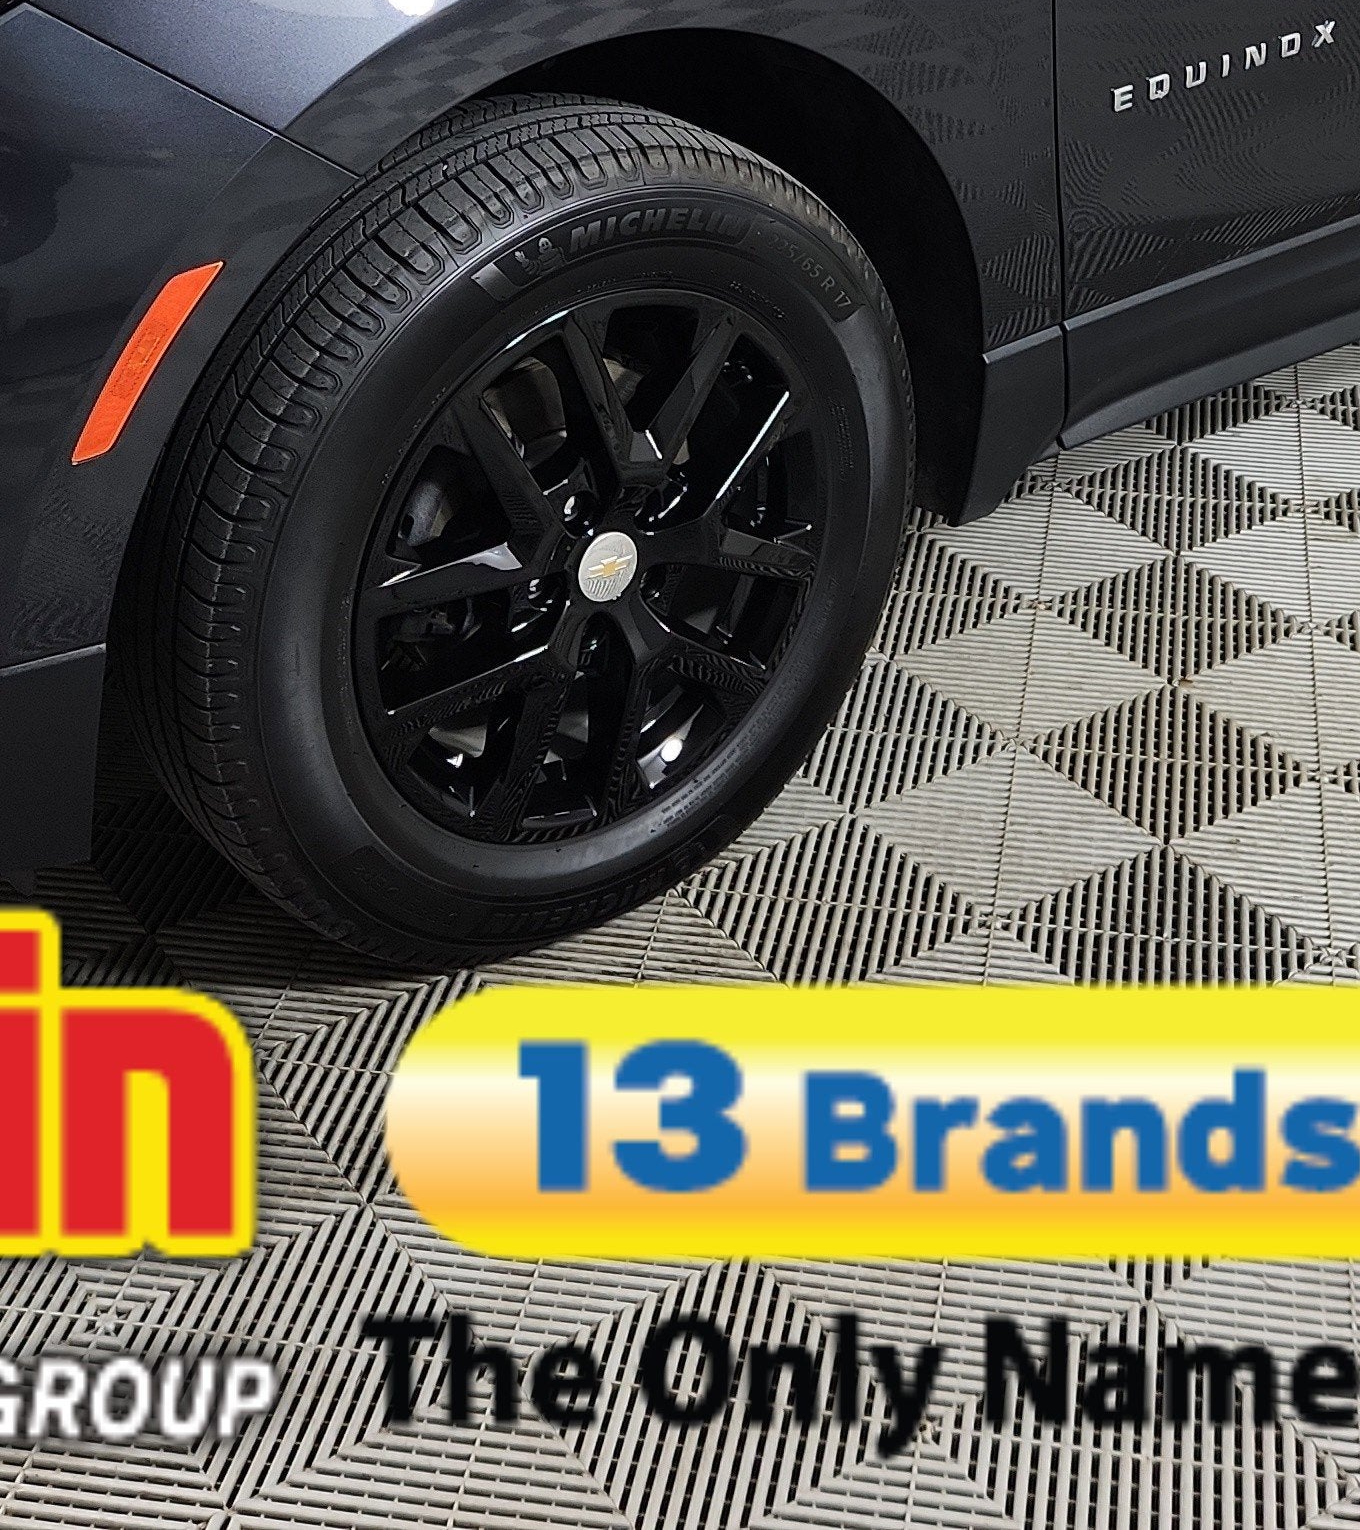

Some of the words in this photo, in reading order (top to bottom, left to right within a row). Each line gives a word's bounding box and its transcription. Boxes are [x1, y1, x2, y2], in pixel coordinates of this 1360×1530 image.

[1112, 20, 1336, 113] EQUINOX
[570, 207, 744, 254] MICHELIN
[820, 275, 836, 293] R
[834, 290, 852, 308] 17
